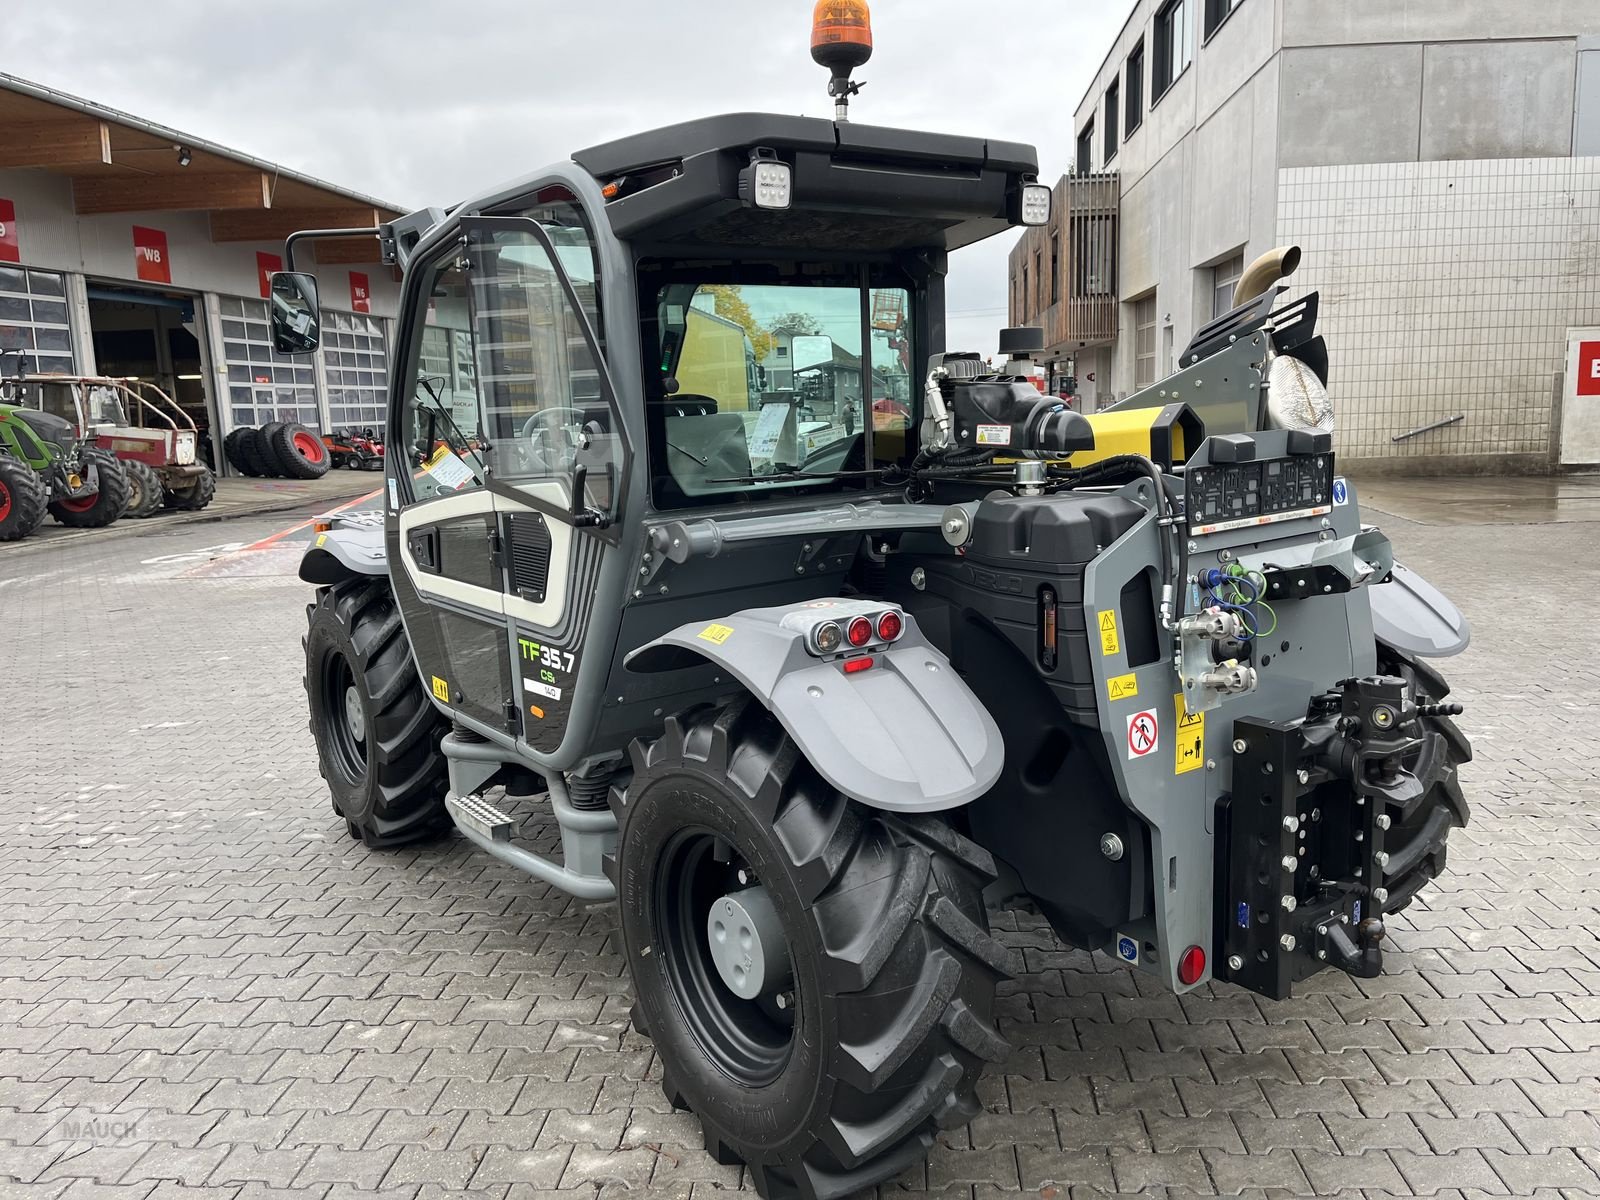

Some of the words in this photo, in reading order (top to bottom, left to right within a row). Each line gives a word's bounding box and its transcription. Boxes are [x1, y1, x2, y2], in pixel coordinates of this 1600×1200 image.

[143, 247, 161, 263] W8
[355, 287, 365, 298] W6
[518, 638, 575, 673] TF35.7
